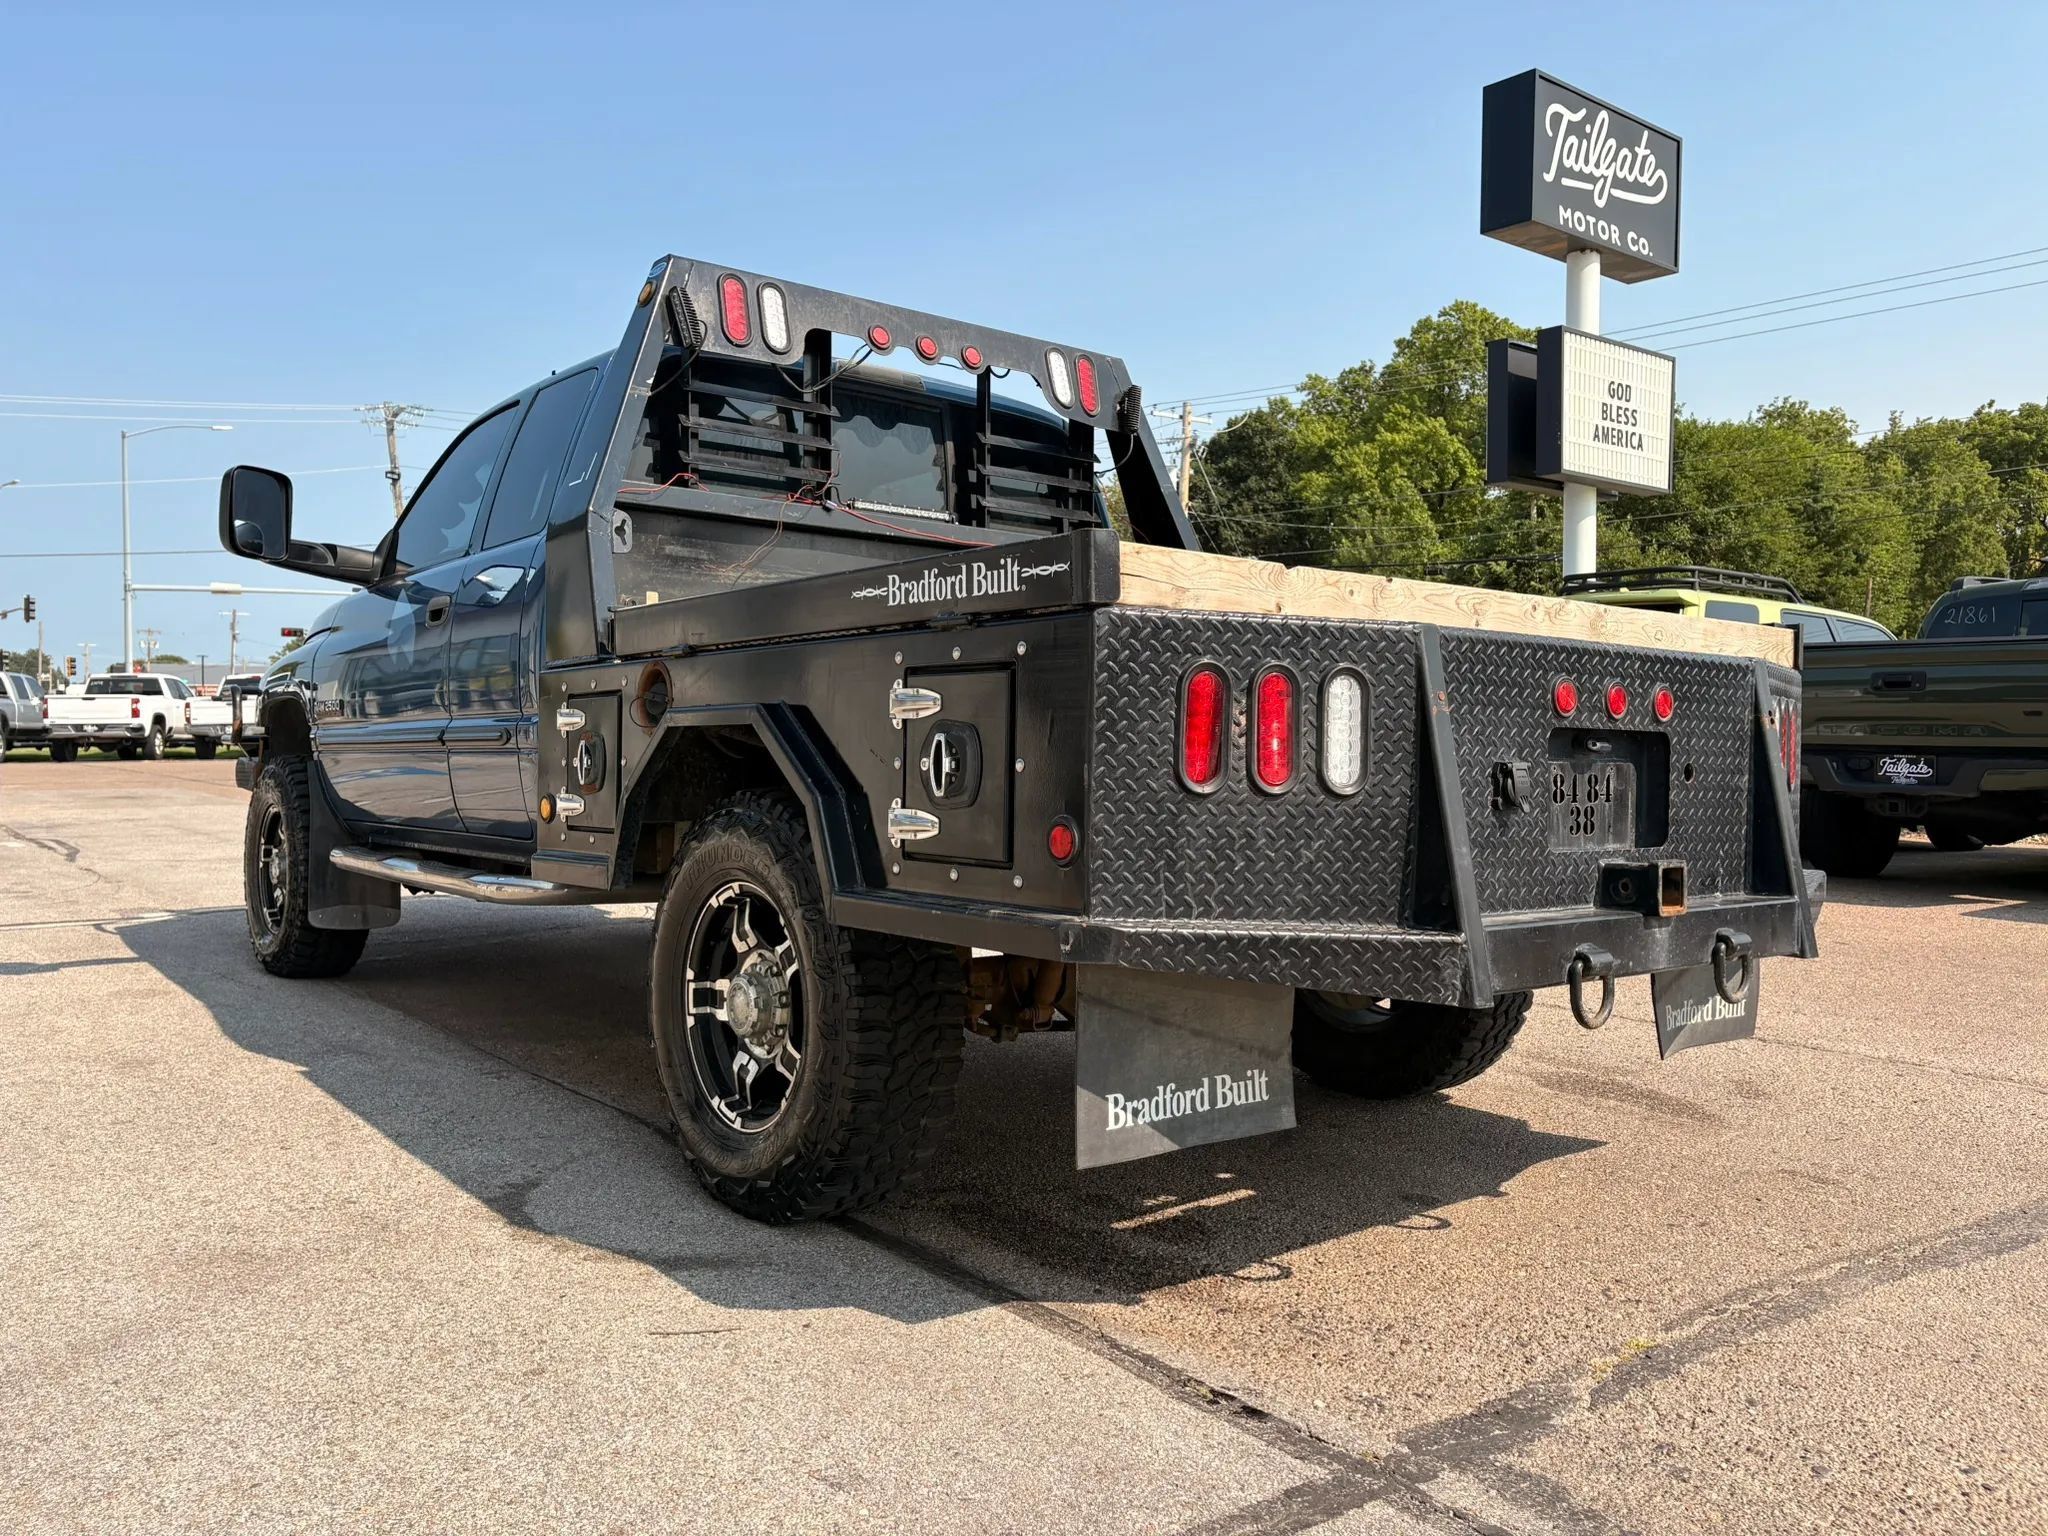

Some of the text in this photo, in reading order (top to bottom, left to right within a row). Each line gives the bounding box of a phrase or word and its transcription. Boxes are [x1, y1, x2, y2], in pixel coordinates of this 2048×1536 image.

[1543, 103, 1668, 208] Tailgate
[1558, 205, 1653, 256] MOTOR CO.
[1608, 380, 1631, 402] GOD
[1601, 402, 1638, 427] BLESS
[1593, 424, 1643, 451] AMERICA
[887, 564, 967, 607] Bradford
[1944, 606, 1996, 624] 21861
[1823, 723, 1988, 737] TACOMA
[1878, 757, 1933, 777] Tailgate
[1569, 805, 1595, 836] 38
[1665, 996, 1713, 1031] Bradford
[1105, 1068, 1270, 1131] Bradford Built
